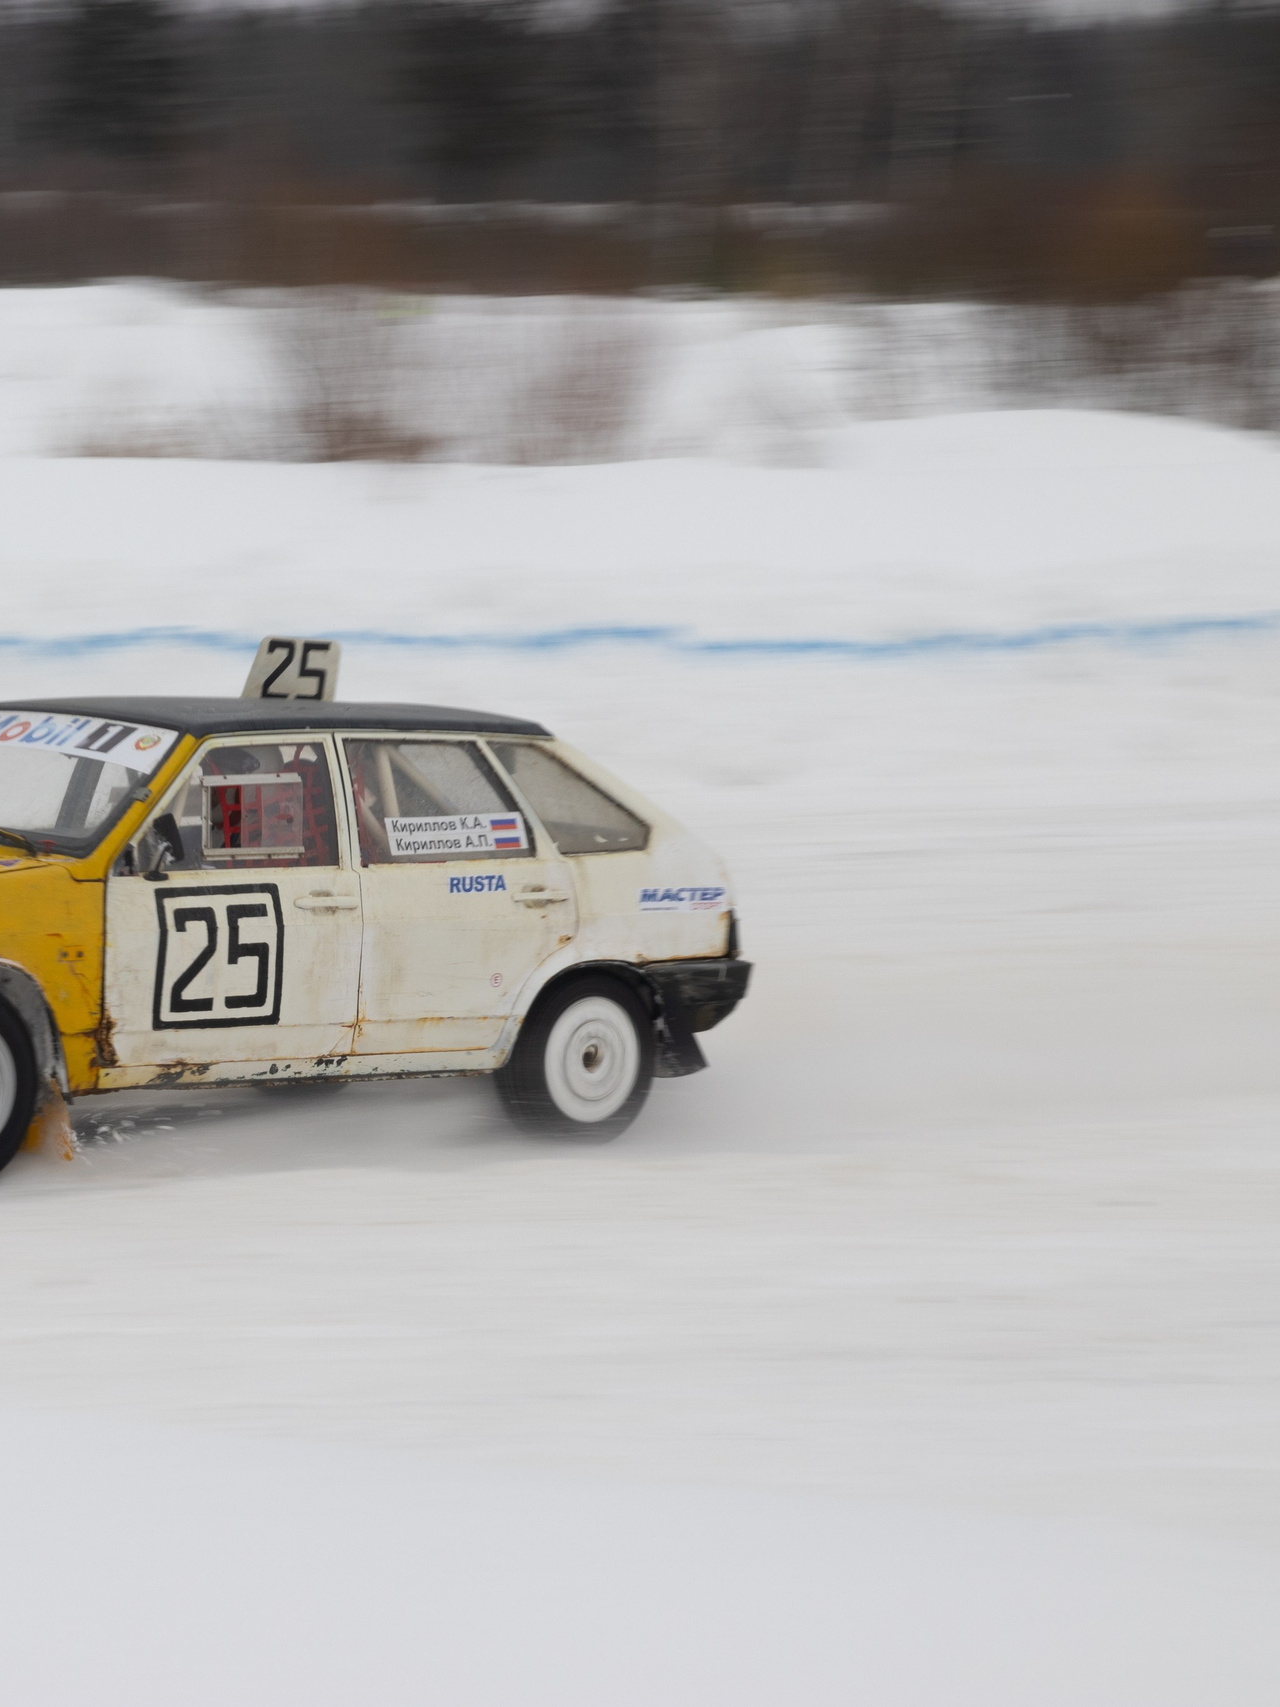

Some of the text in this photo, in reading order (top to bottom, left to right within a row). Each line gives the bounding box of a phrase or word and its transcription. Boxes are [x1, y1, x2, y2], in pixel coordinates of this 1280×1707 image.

[261, 638, 332, 700] 25
[391, 816, 487, 835] Кириллов К.А.
[395, 834, 493, 853] Кириллов А.П.
[449, 874, 507, 893] RUSTA
[170, 903, 269, 1013] 25
